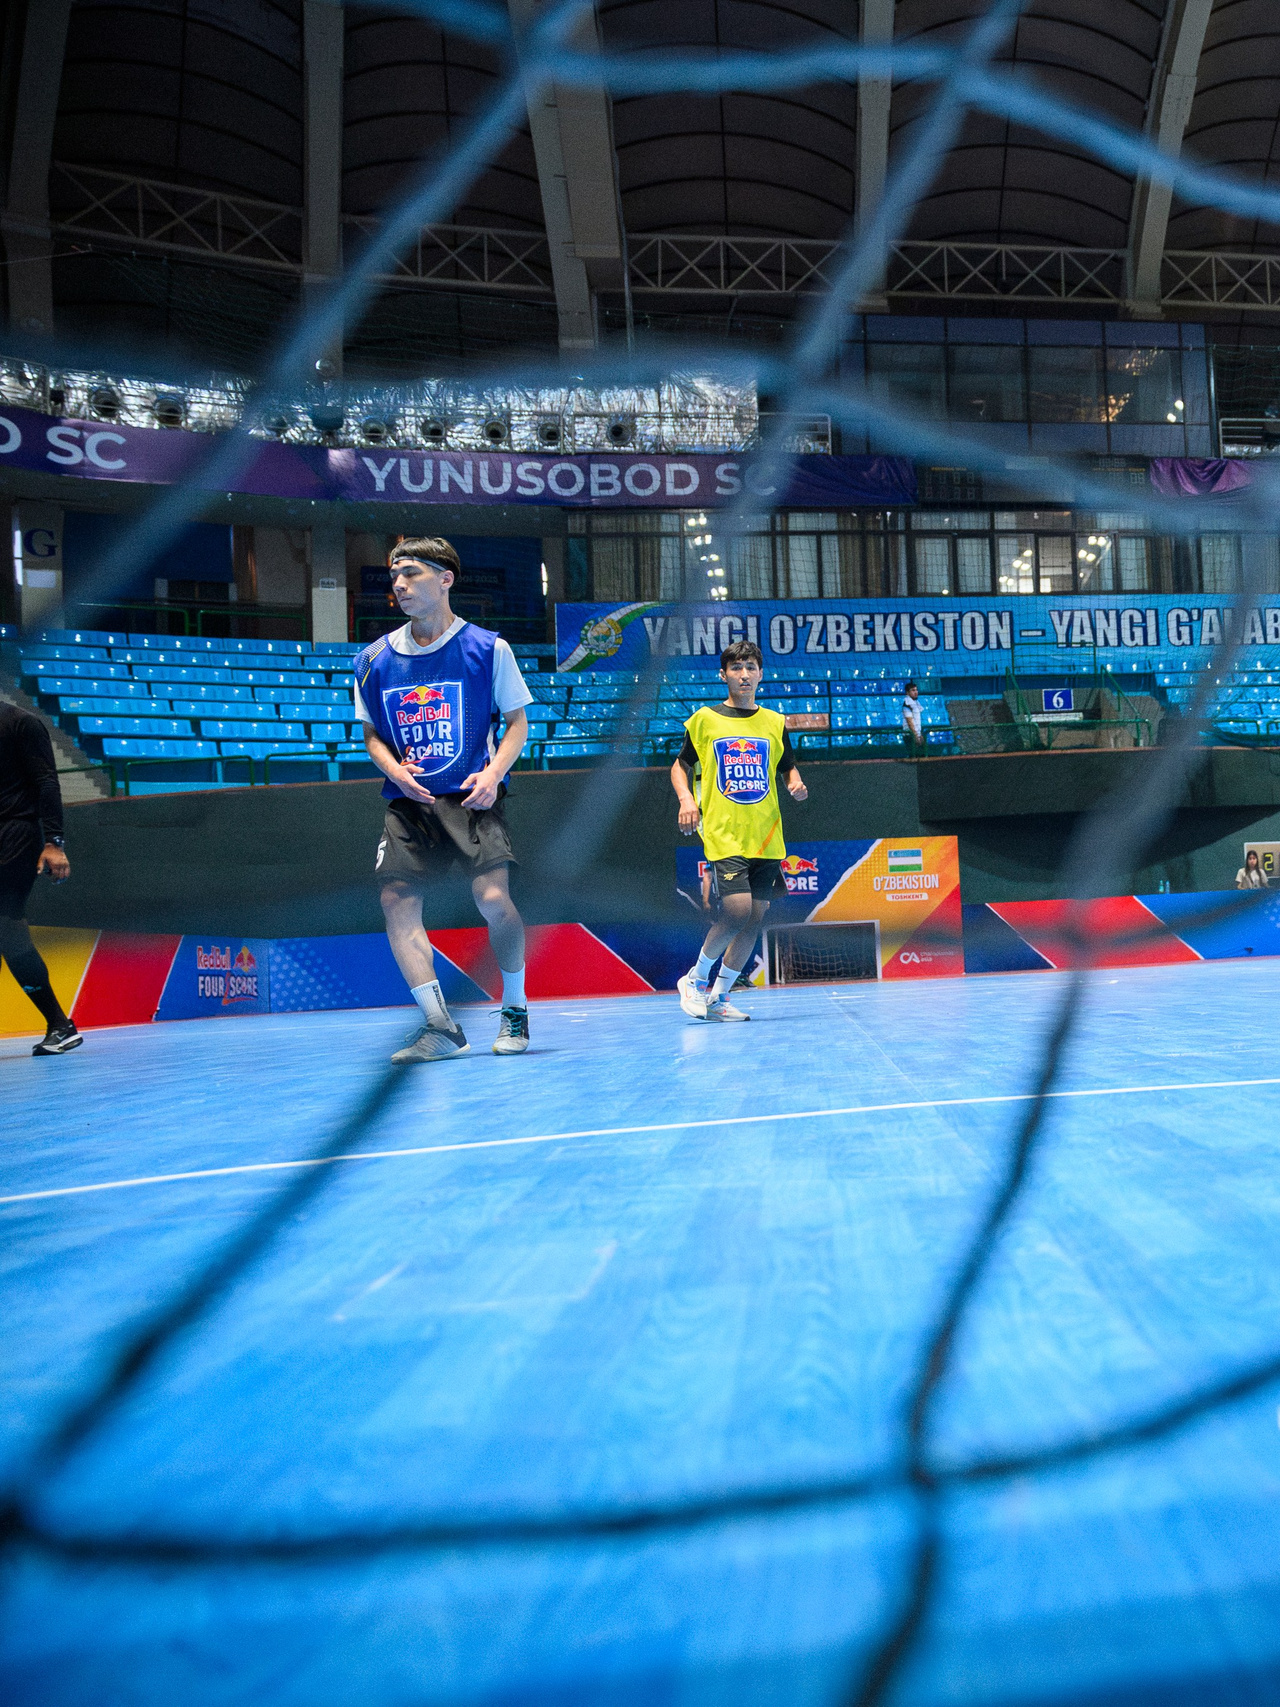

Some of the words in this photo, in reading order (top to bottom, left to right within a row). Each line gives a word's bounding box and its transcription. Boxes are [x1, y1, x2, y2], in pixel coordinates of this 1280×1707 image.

[46, 426, 127, 469] SC
[361, 457, 701, 496] YUNUSOBOD
[24, 528, 57, 558] G
[643, 615, 757, 656] YANGI
[769, 611, 1012, 655] O'ZBEKISTON
[1050, 609, 1157, 648] YANGI
[1051, 691, 1065, 709] 6
[396, 707, 424, 726] Red
[425, 703, 450, 721] Bull
[400, 720, 453, 745] FOUR
[723, 754, 744, 765] Red
[745, 754, 762, 765] Bull
[725, 765, 765, 780] FOUR
[1264, 853, 1274, 871] 2
[786, 876, 818, 892] ORE
[873, 874, 939, 891] O'ZBEKISTON
[198, 975, 224, 997] FOUR
[229, 976, 258, 997] SCORE
